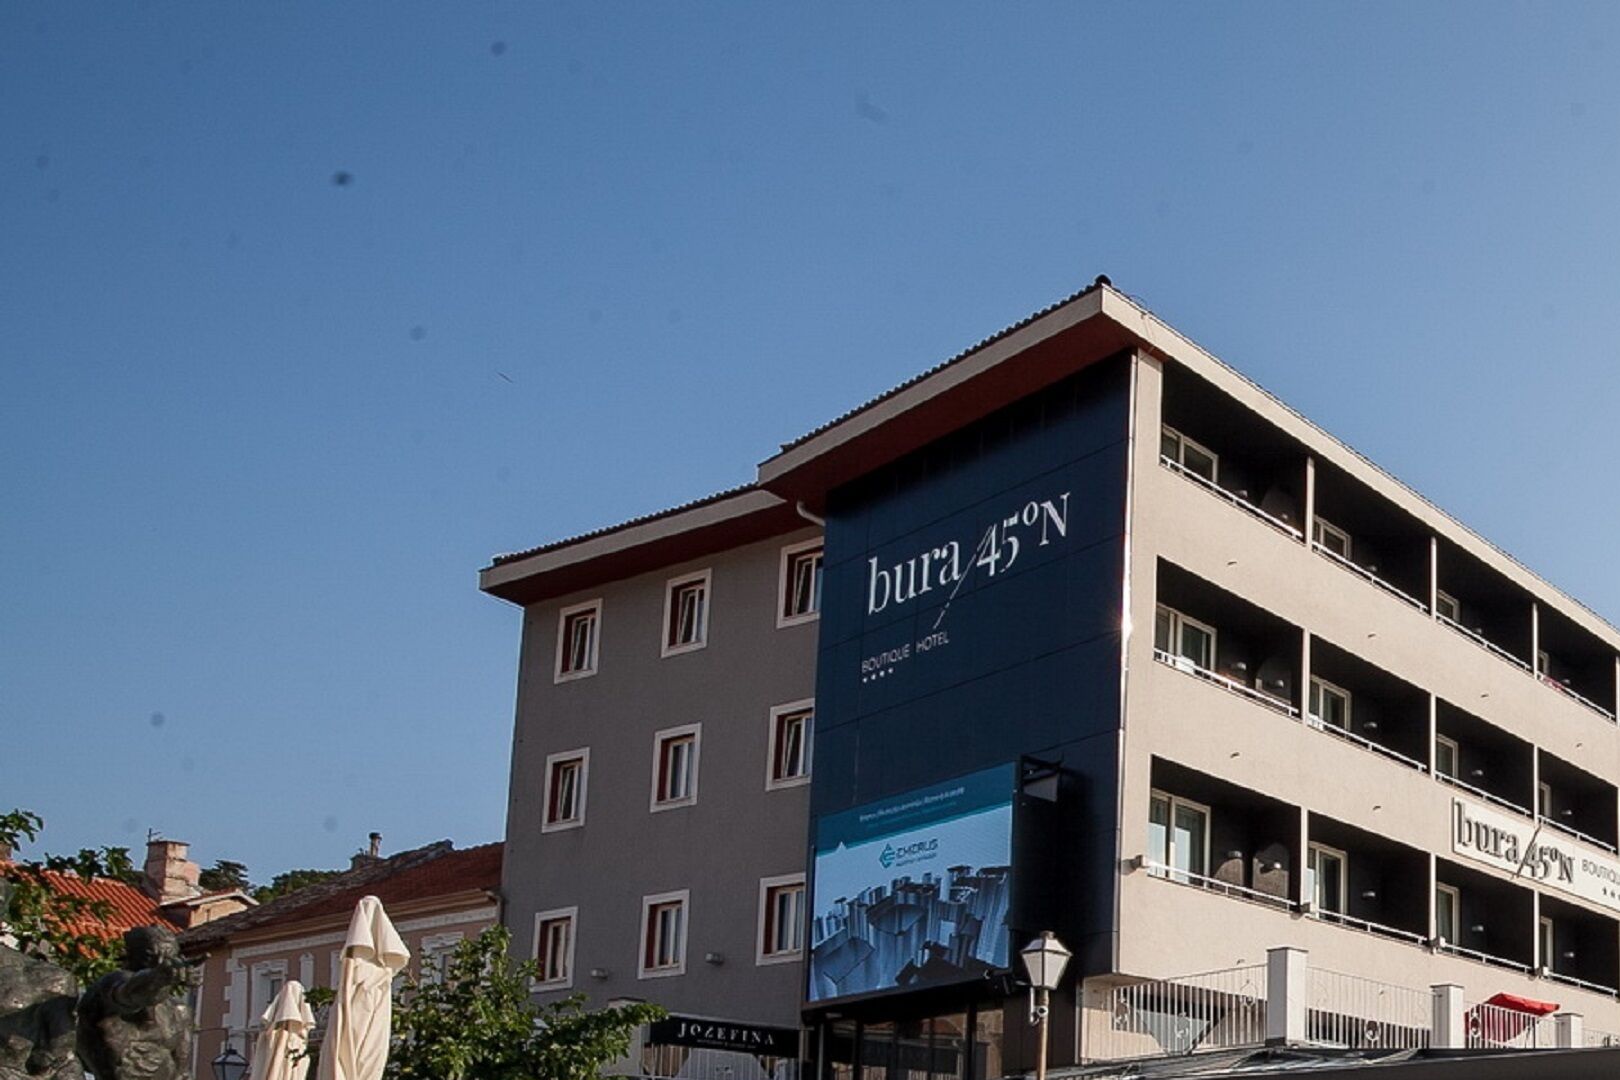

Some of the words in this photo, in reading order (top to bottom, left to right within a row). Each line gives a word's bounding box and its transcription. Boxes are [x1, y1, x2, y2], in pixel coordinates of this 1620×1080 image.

[868, 541, 962, 616] bura
[862, 643, 910, 673] BOUTIQUE
[915, 632, 949, 653] HOTEL
[1455, 801, 1519, 865] bura
[678, 1023, 775, 1045] JOZEFINA
